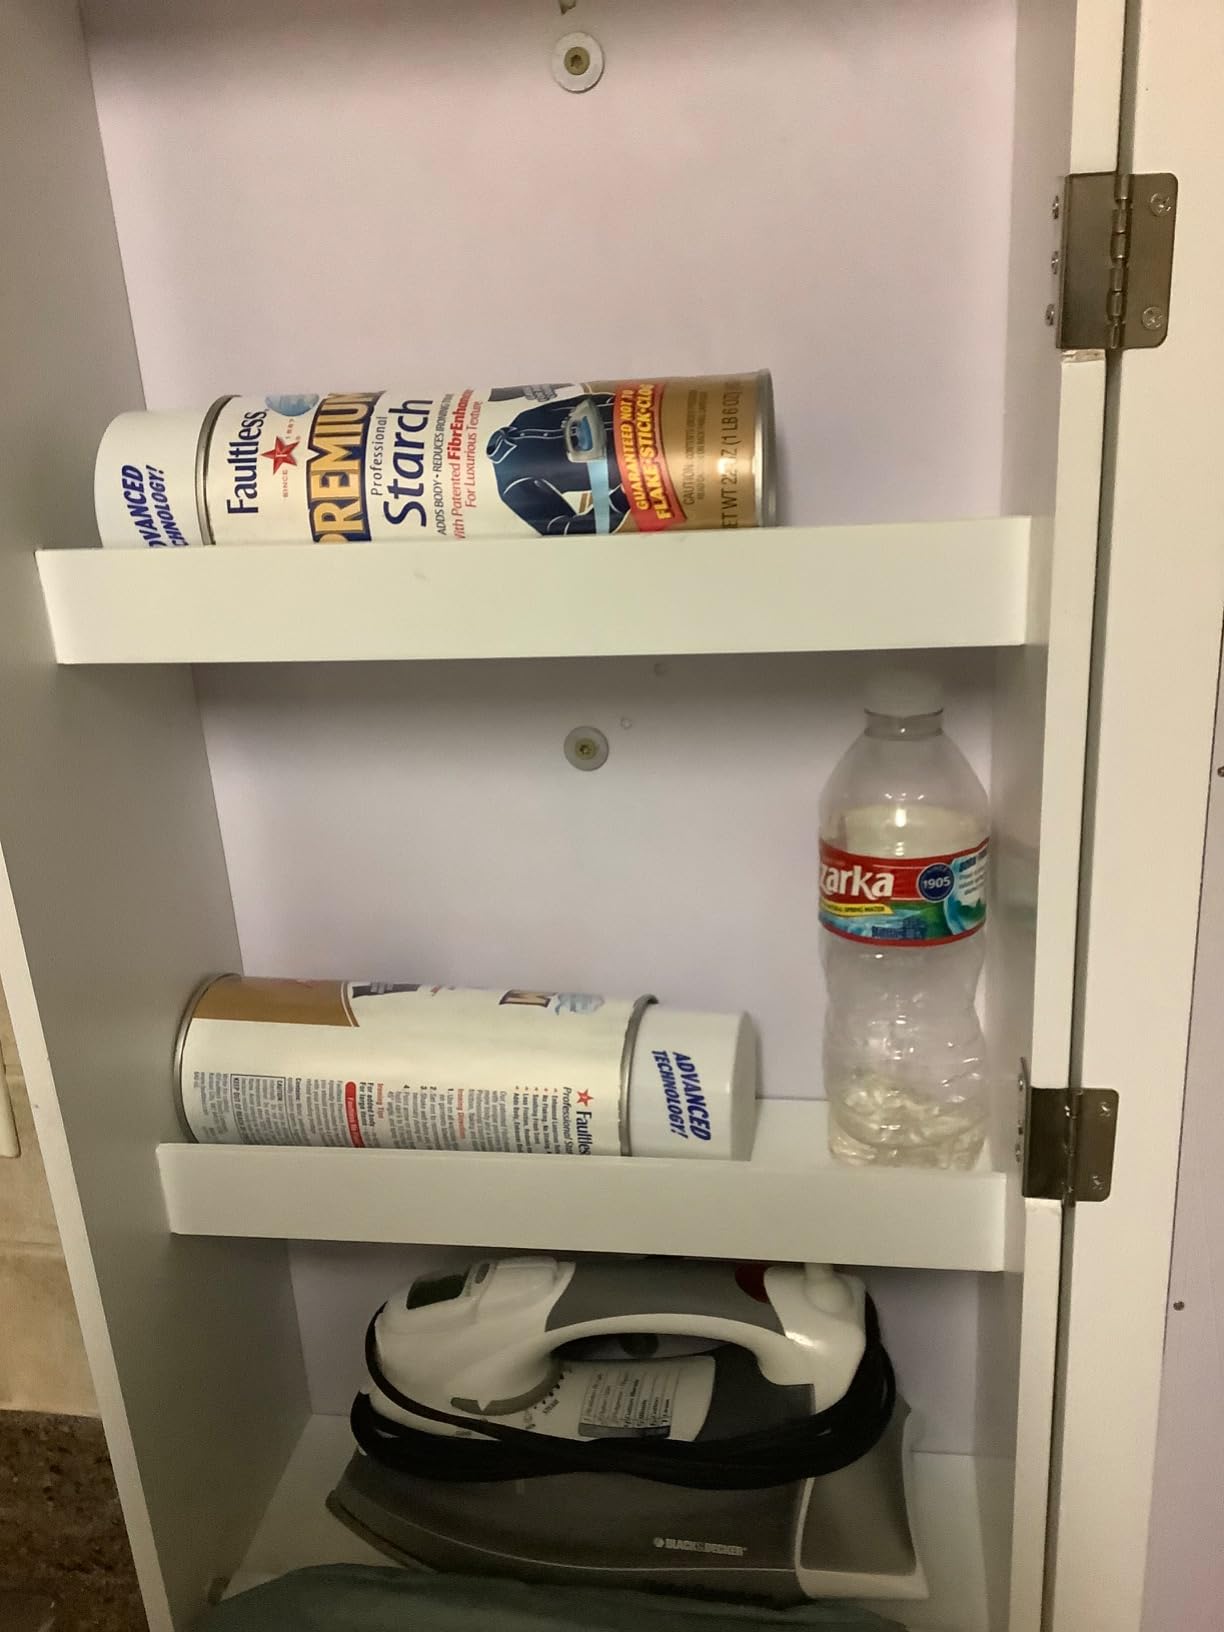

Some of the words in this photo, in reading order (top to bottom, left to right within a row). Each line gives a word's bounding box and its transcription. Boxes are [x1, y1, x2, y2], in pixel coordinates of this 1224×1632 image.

[466, 401, 482, 430] Texture
[620, 401, 633, 420] NOT
[722, 416, 737, 431] LB
[227, 411, 267, 514] Faultless
[370, 416, 387, 496] Professional
[383, 400, 433, 527] Starch
[432, 433, 444, 472] REDUCES
[464, 433, 477, 486] Luxurious
[622, 424, 648, 510] GUARANTEED
[146, 465, 189, 546] CHNOLOGY!
[433, 480, 444, 507] BODY
[449, 463, 464, 516] Patented
[465, 489, 477, 507] For
[721, 488, 737, 509] WT
[434, 509, 447, 535] ADDS
[923, 876, 950, 889] 1905
[562, 1087, 573, 1139] Professional
[651, 1050, 689, 1140] TECHNOLOGY!
[672, 1051, 711, 1141] ADVANCED
